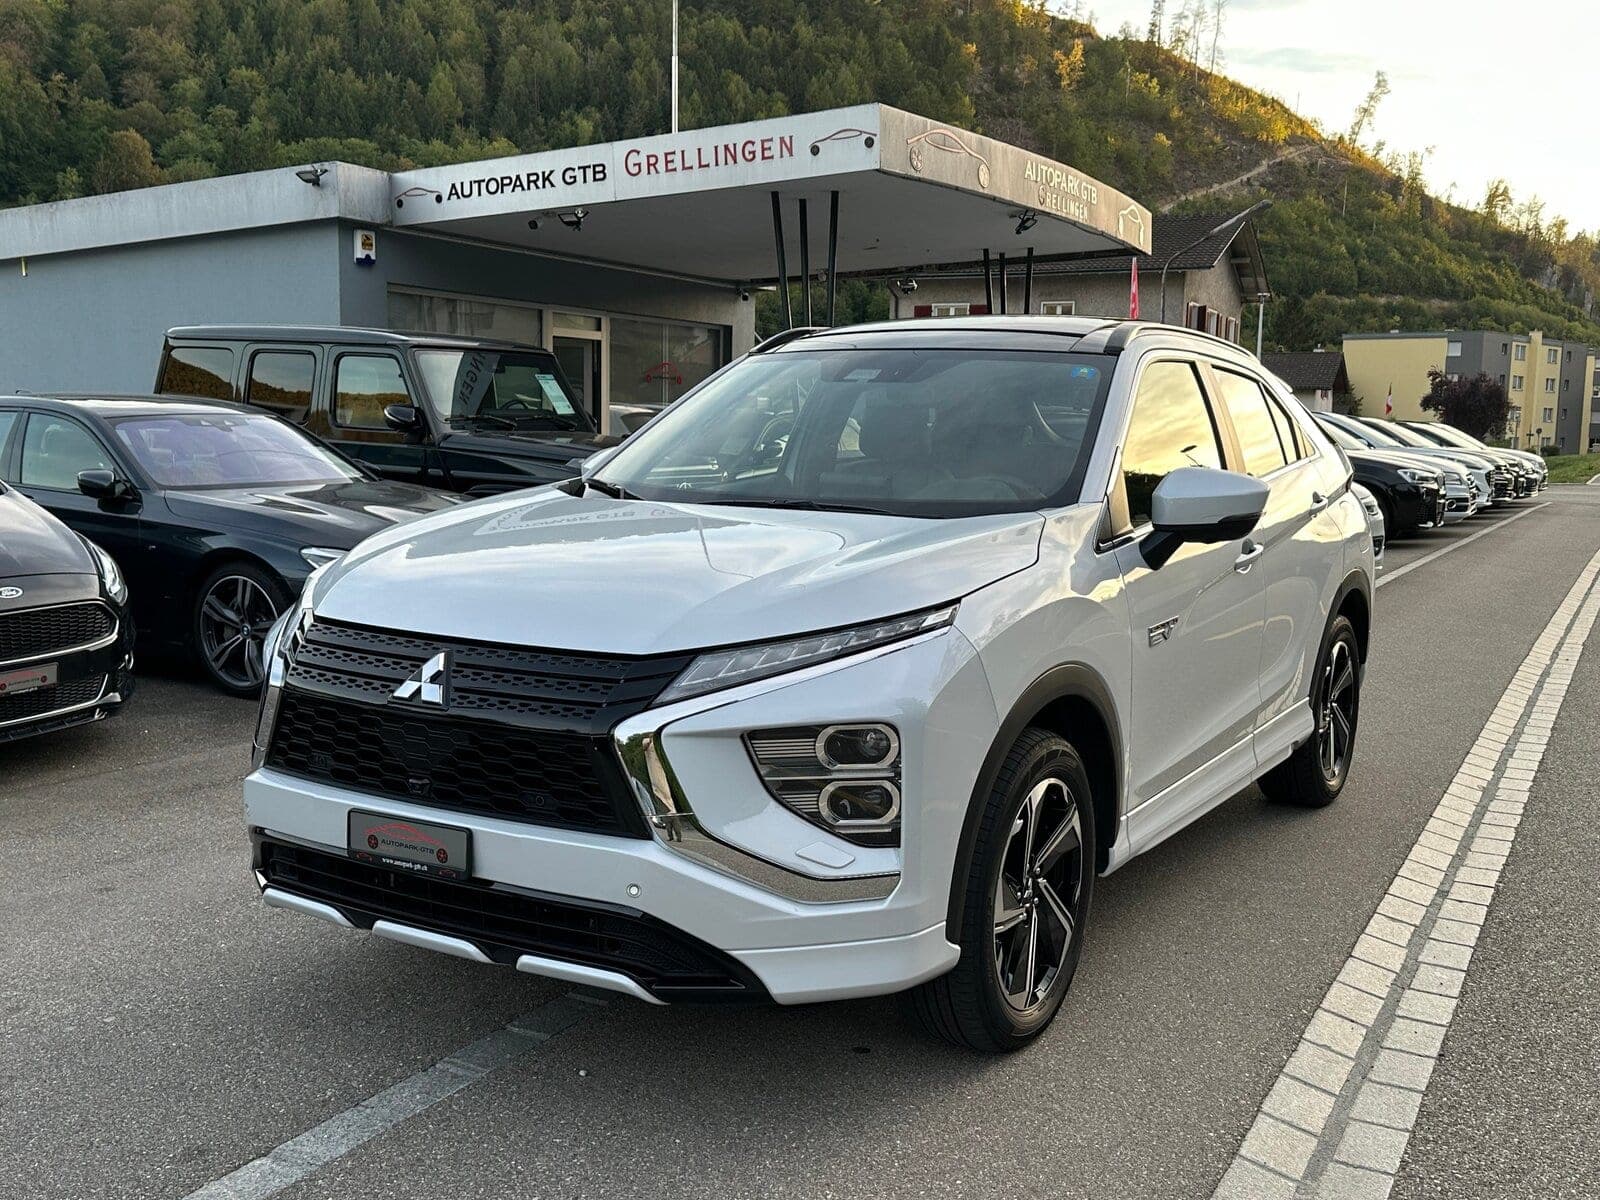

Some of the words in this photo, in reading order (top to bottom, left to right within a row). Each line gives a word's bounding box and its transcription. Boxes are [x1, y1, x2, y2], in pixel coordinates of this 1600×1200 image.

[447, 169, 556, 201] AUTOPARK
[561, 163, 607, 186] GTB
[624, 135, 795, 177] GRELLINGEN
[1024, 160, 1081, 197] AUTOPARK
[1081, 182, 1098, 205] GTB
[1038, 185, 1089, 220] GRELLINGEN
